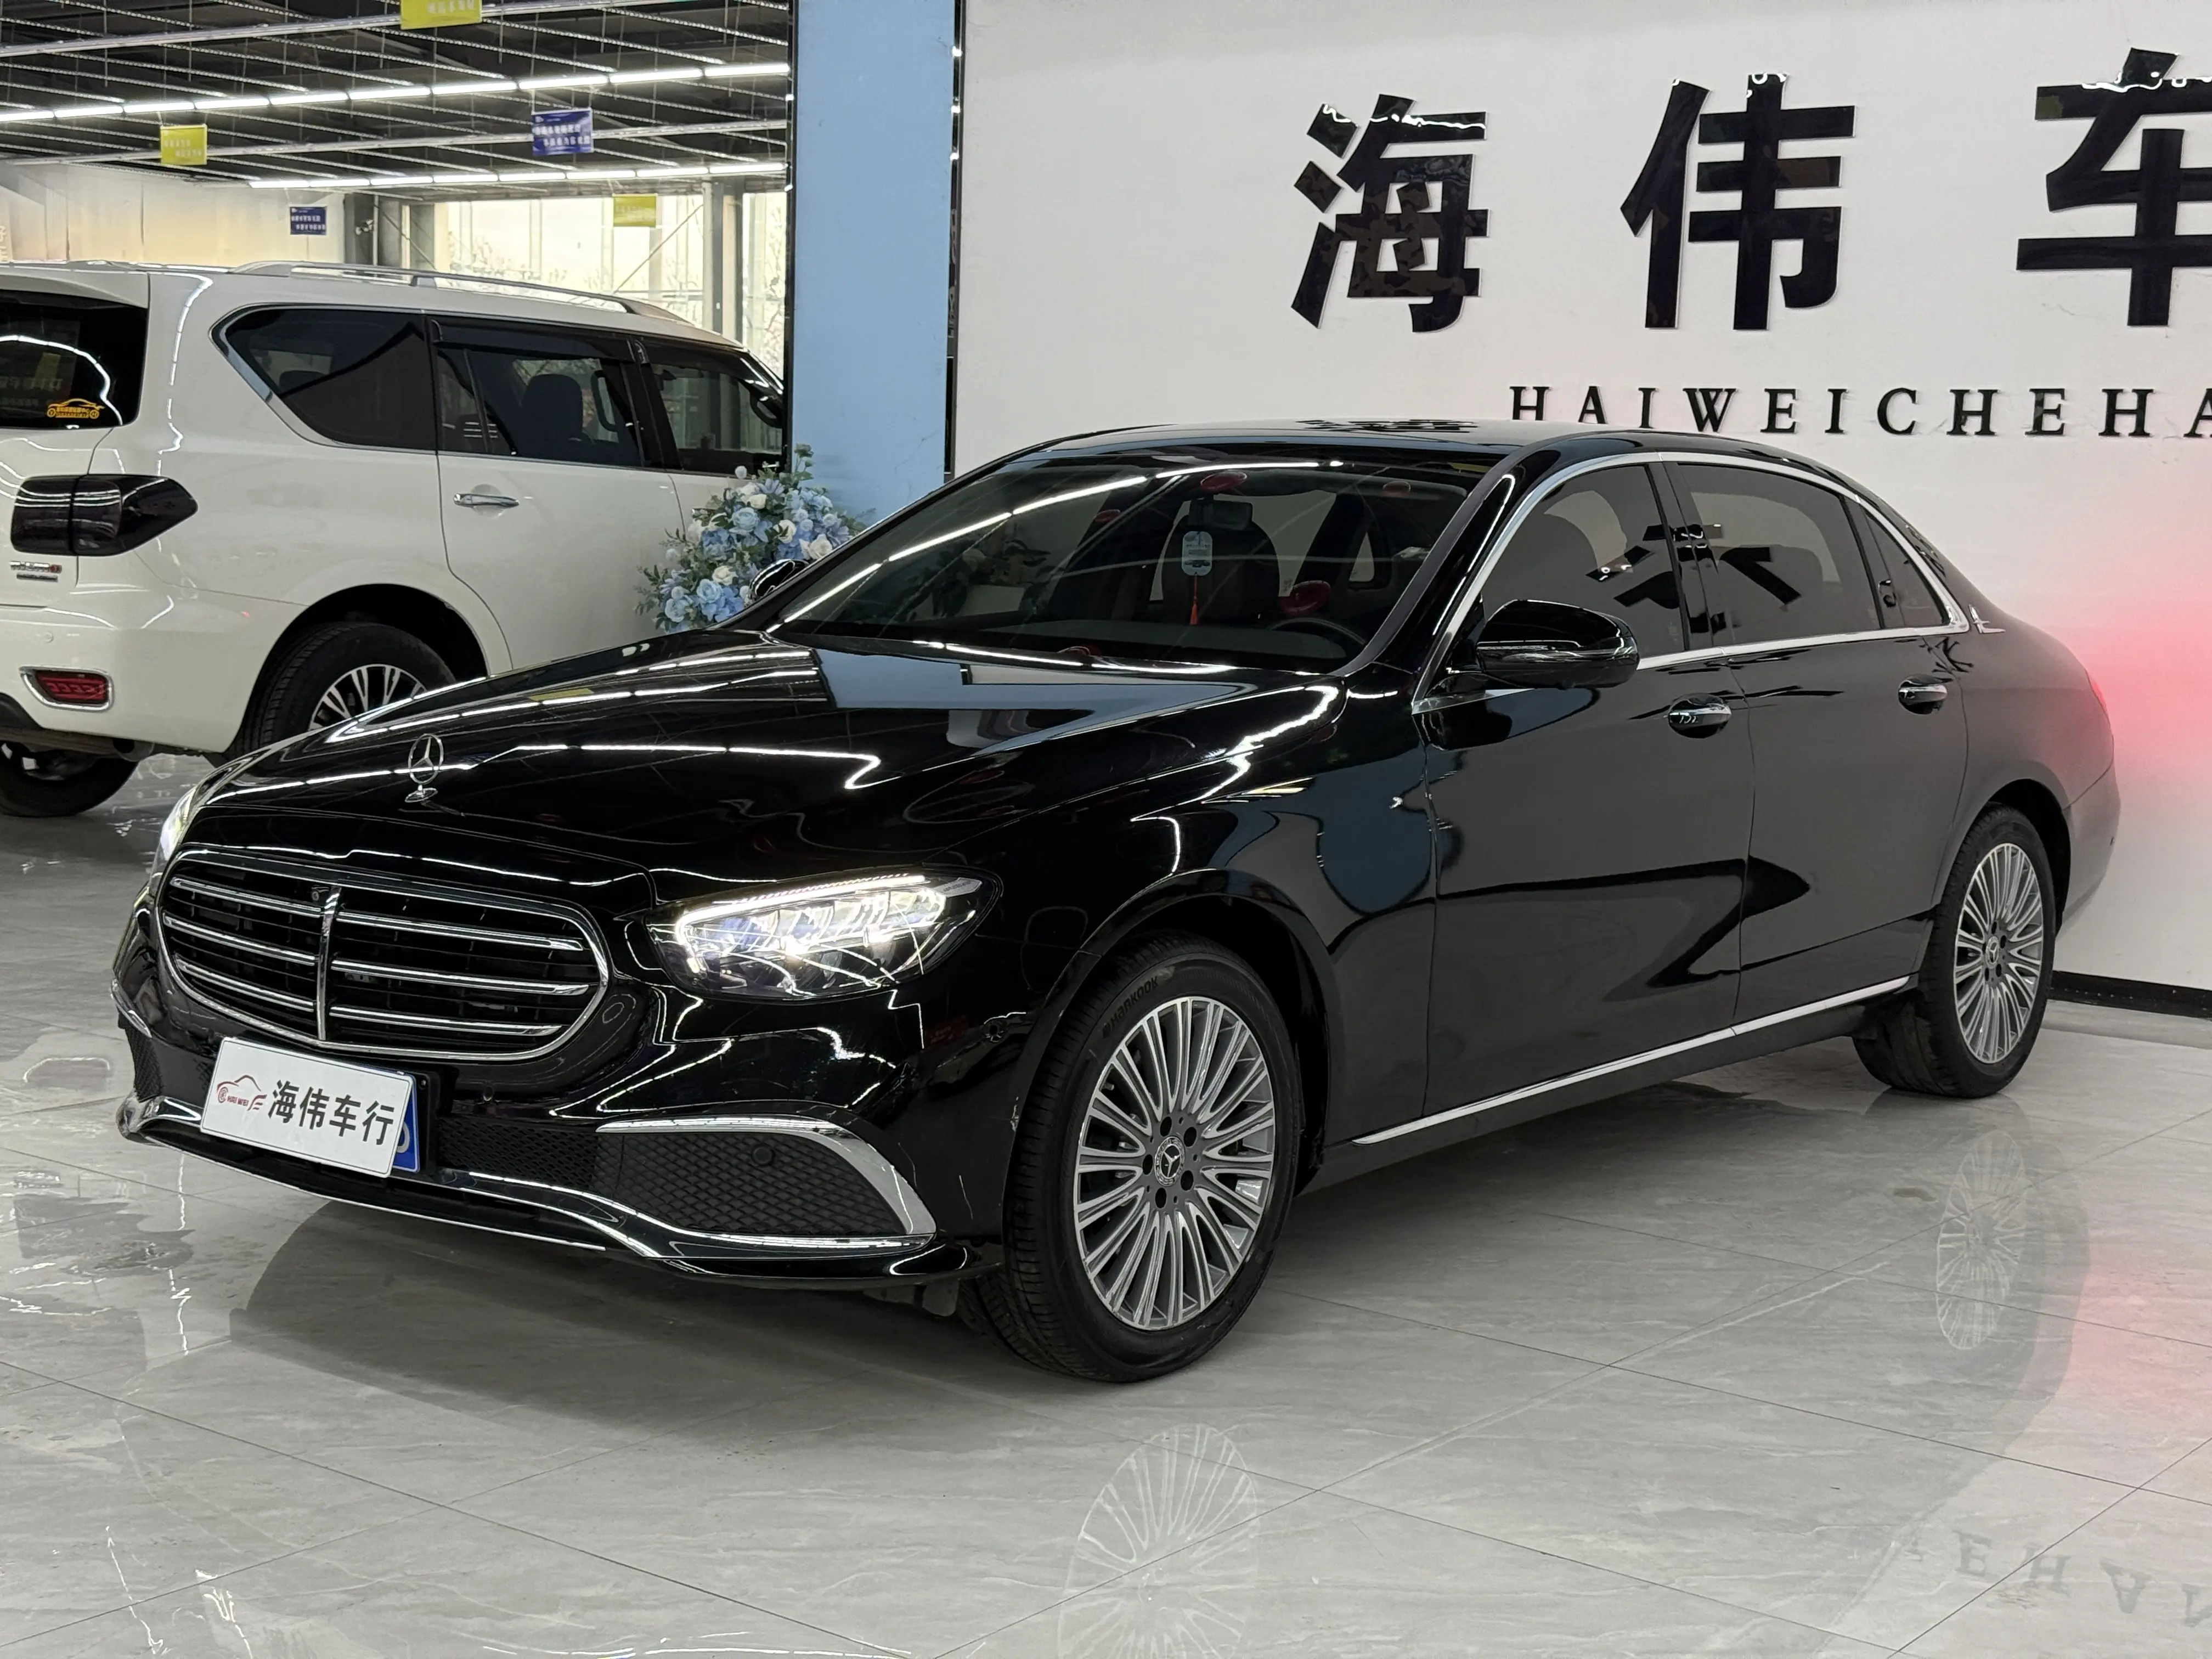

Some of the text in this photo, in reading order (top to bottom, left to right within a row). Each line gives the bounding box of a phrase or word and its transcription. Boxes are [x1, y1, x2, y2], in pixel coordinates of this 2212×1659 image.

[1291, 48, 2212, 332] 海伟车
[268, 1079, 394, 1146] 海伟车行
